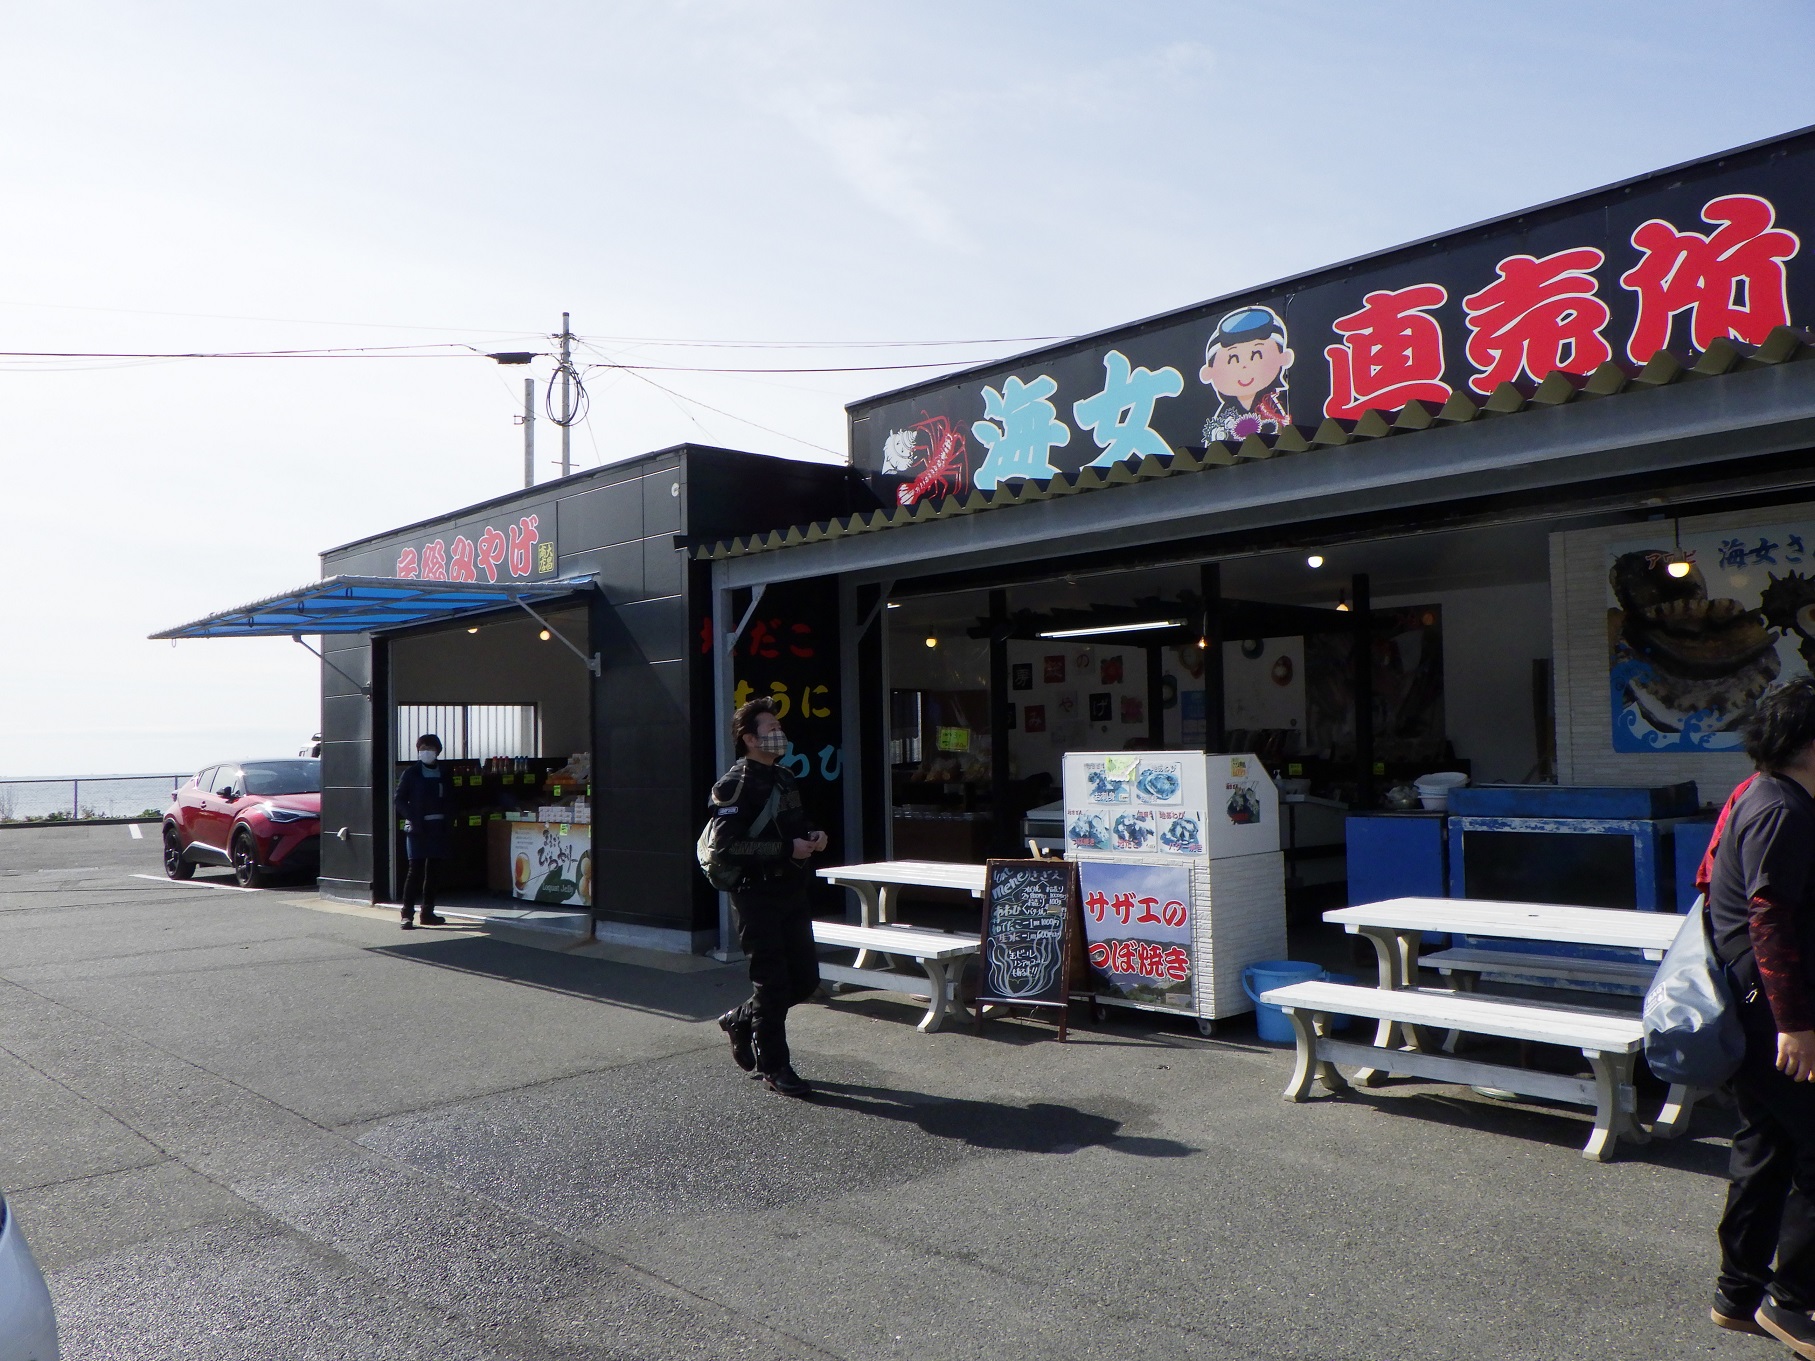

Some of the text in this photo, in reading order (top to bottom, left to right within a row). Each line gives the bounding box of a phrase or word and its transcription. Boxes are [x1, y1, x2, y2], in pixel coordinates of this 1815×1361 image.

[972, 193, 1800, 490] 海女 直売所
[1717, 533, 1815, 571] 海女さ
[1085, 891, 1188, 927] サザエの
[1088, 940, 1190, 982] つぼ焼き
